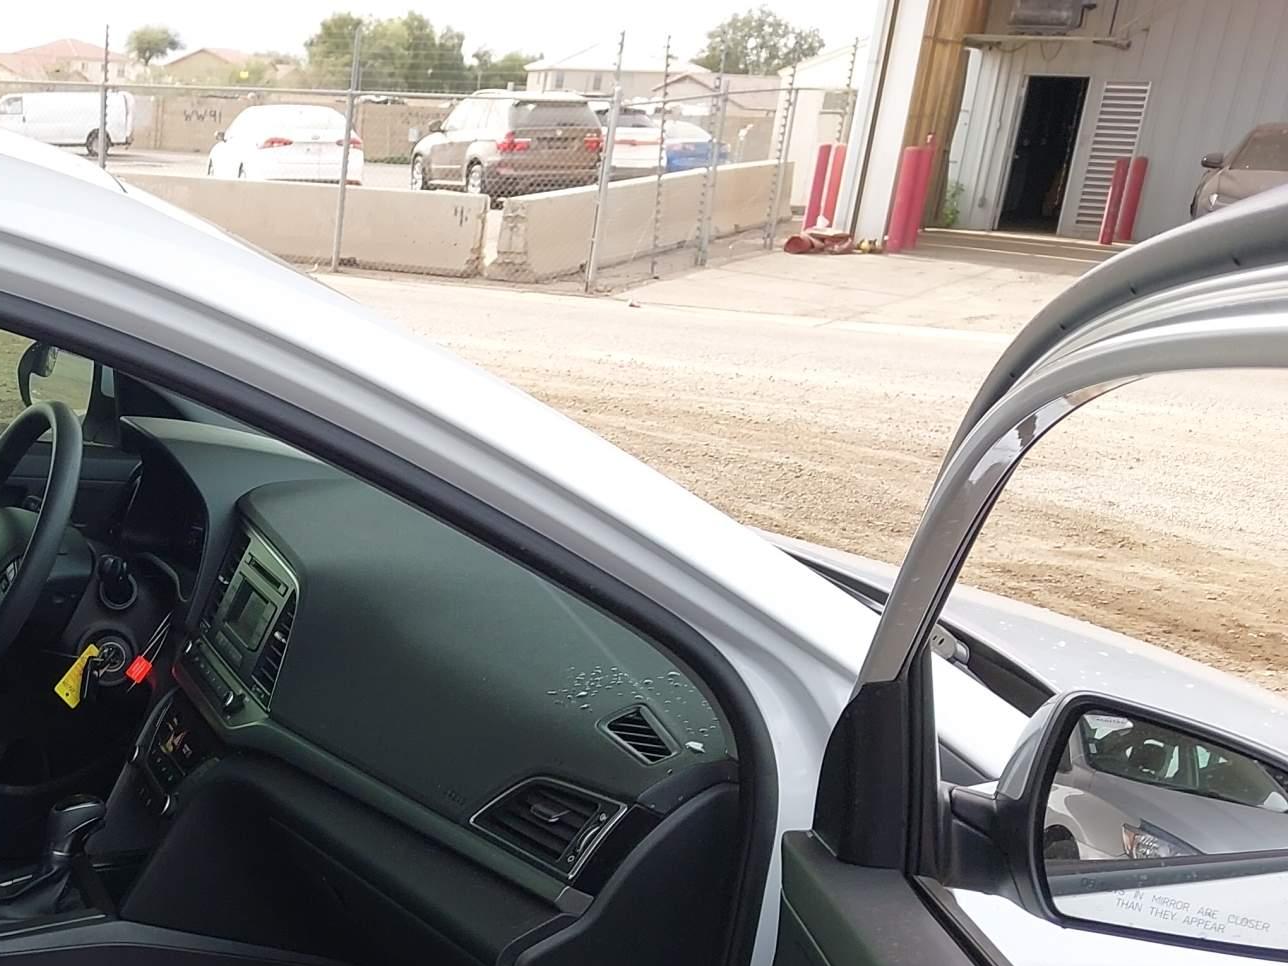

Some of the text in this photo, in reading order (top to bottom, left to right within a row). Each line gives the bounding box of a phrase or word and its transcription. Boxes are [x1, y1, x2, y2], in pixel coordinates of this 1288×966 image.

[1116, 897, 1226, 933] THAN THEY APPEAR
[1133, 888, 1144, 901] IN
[1151, 894, 1191, 912] MIRROR
[1197, 906, 1219, 919] ARE
[1227, 914, 1271, 932] CLOSER
